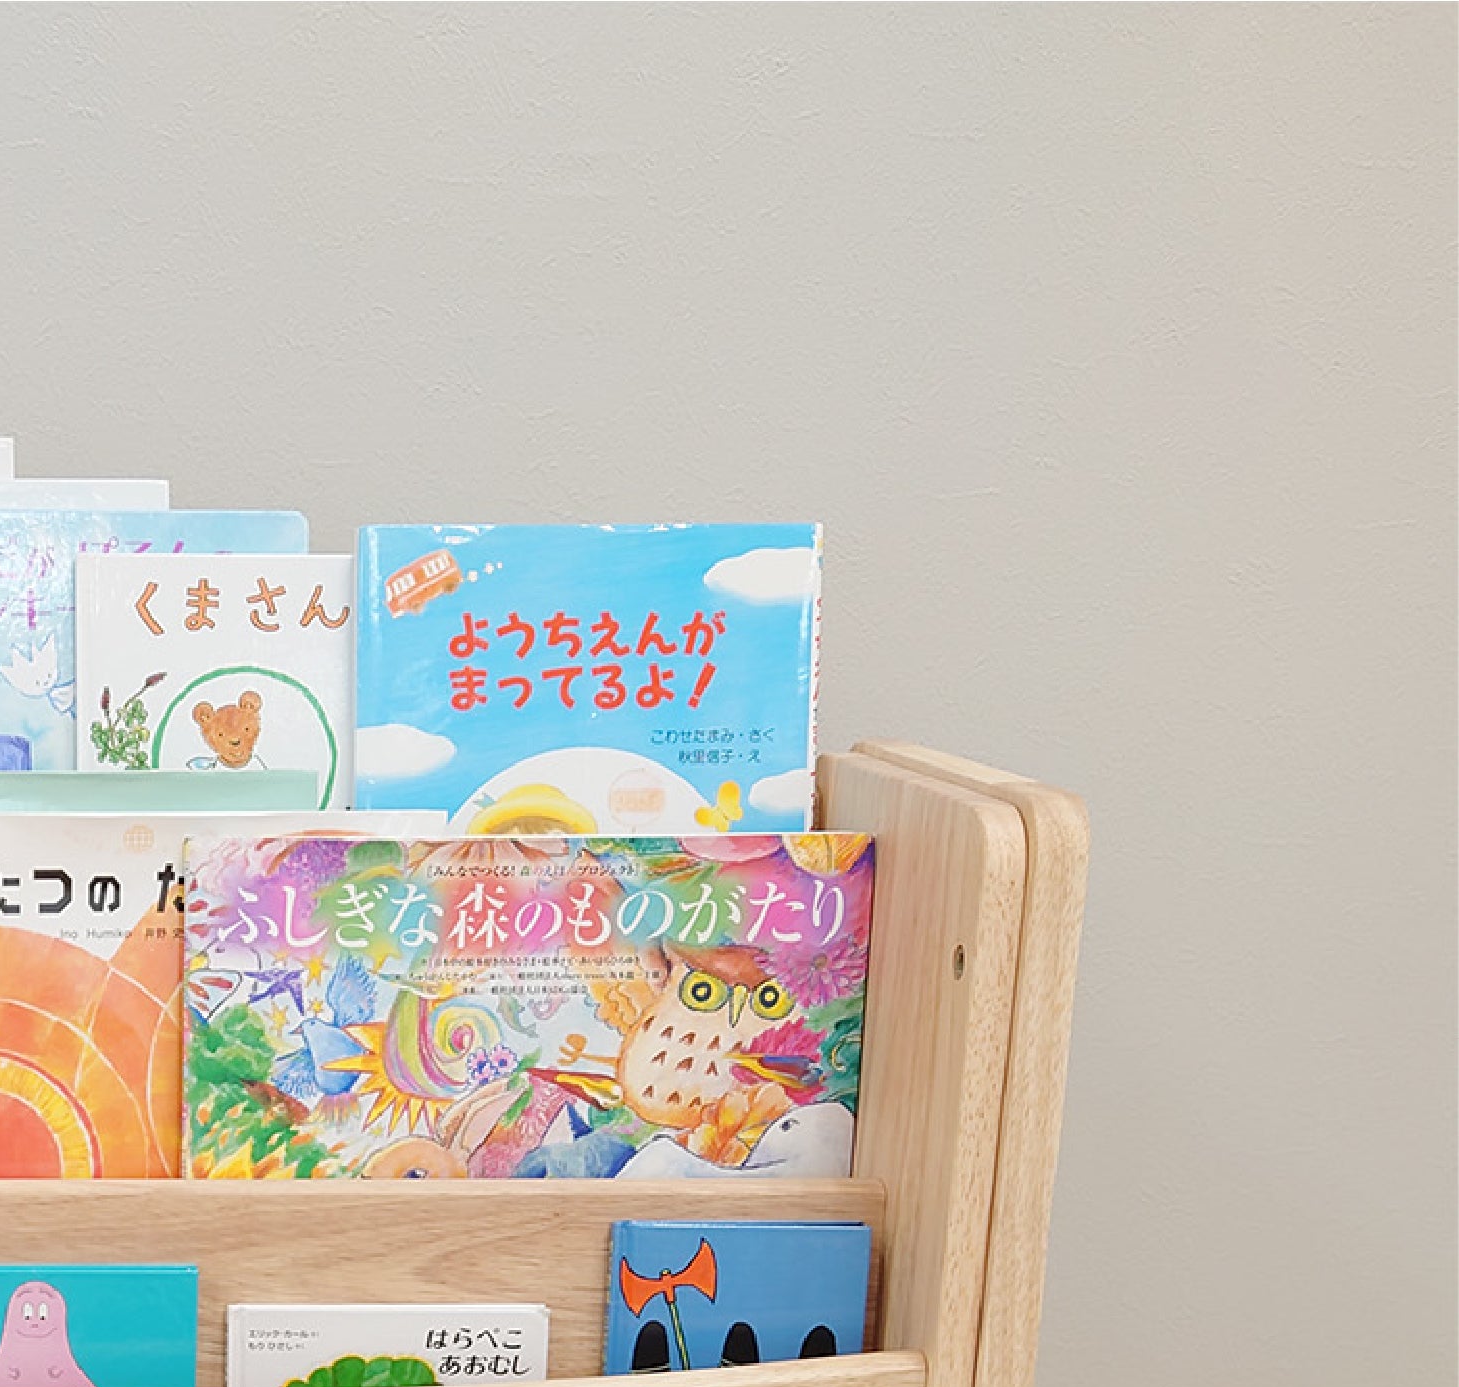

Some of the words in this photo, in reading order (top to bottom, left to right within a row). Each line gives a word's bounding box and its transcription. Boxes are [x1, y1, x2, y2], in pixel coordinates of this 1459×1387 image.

[134, 577, 350, 635] くまさん
[448, 610, 727, 659] ようちえんが
[448, 662, 717, 711] まってるよ!
[220, 882, 847, 948] ふしぎな森のものがたり
[425, 1327, 522, 1350] はらぺこ
[439, 1354, 530, 1376] あおむし
